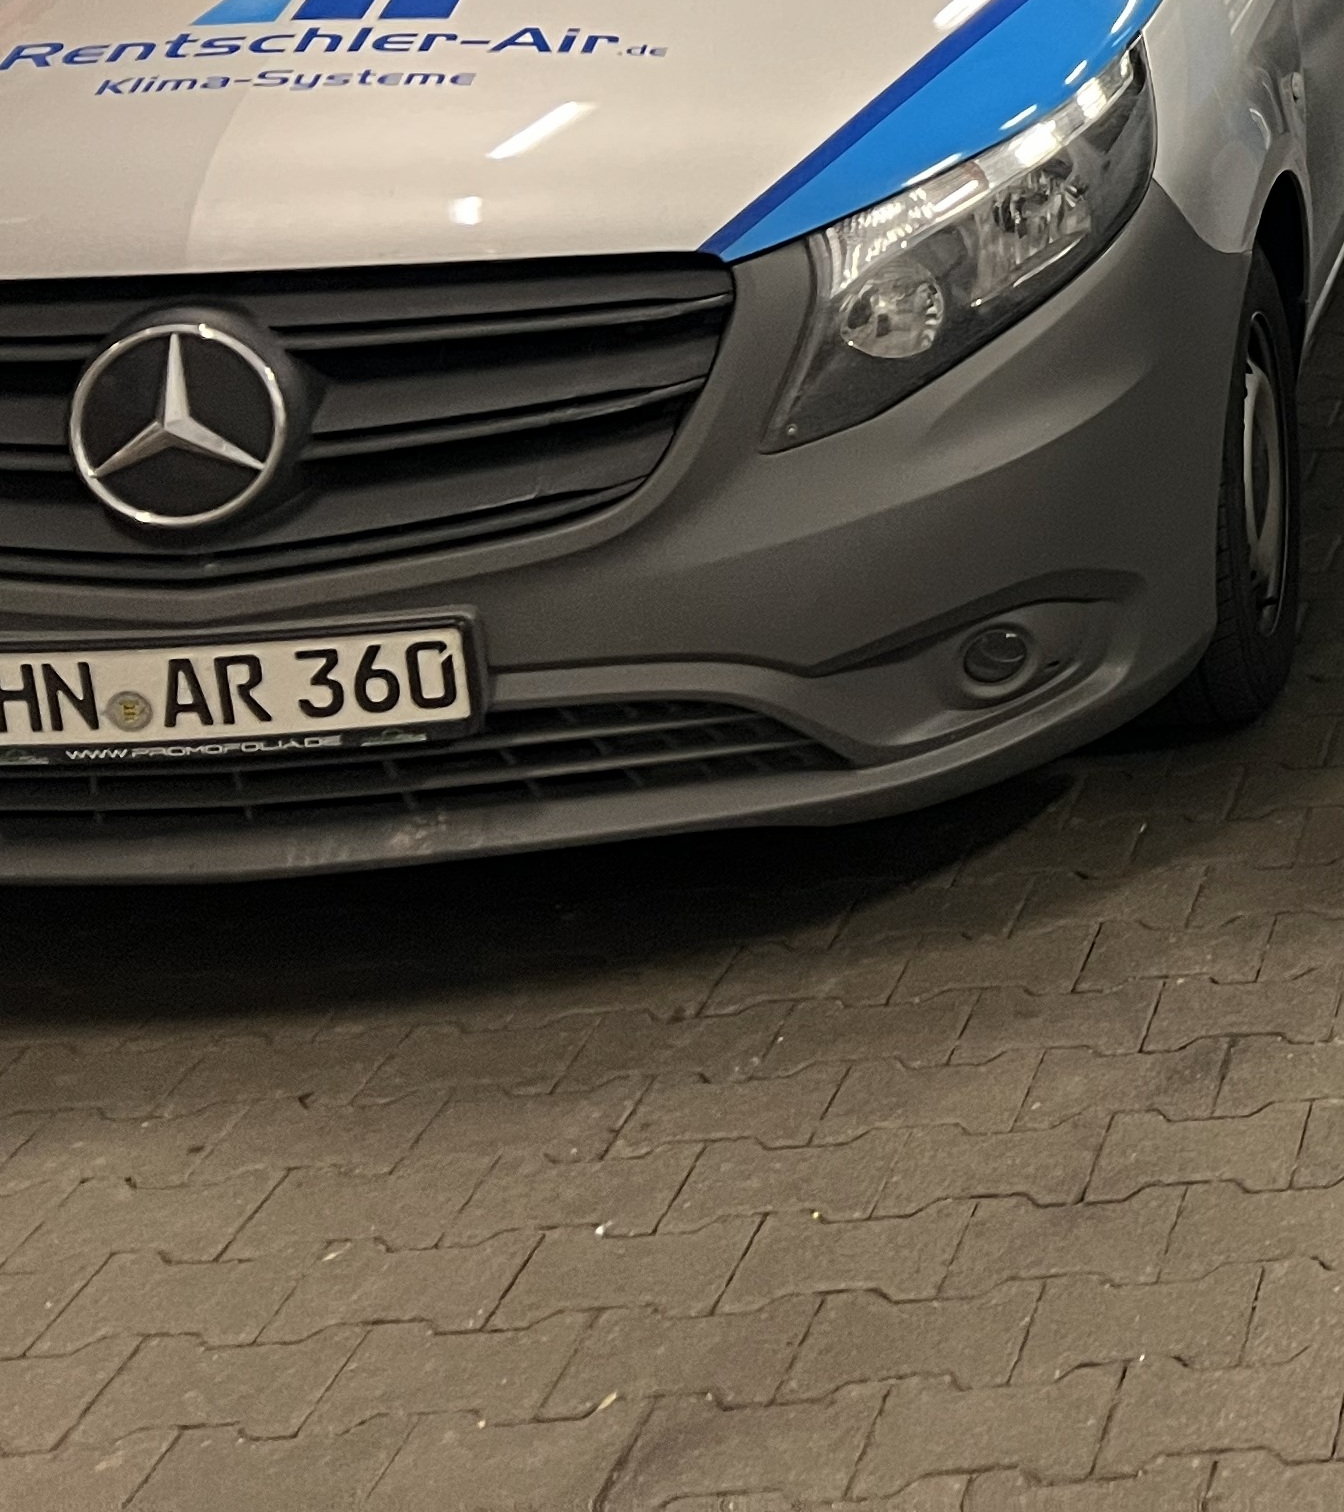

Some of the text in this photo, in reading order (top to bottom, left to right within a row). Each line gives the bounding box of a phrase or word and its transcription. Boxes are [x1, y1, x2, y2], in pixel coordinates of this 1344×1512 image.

[0, 26, 669, 71] Rentschler-Air.de
[94, 69, 478, 96] Klima-Systeme
[0, 640, 458, 733] HN AR 360
